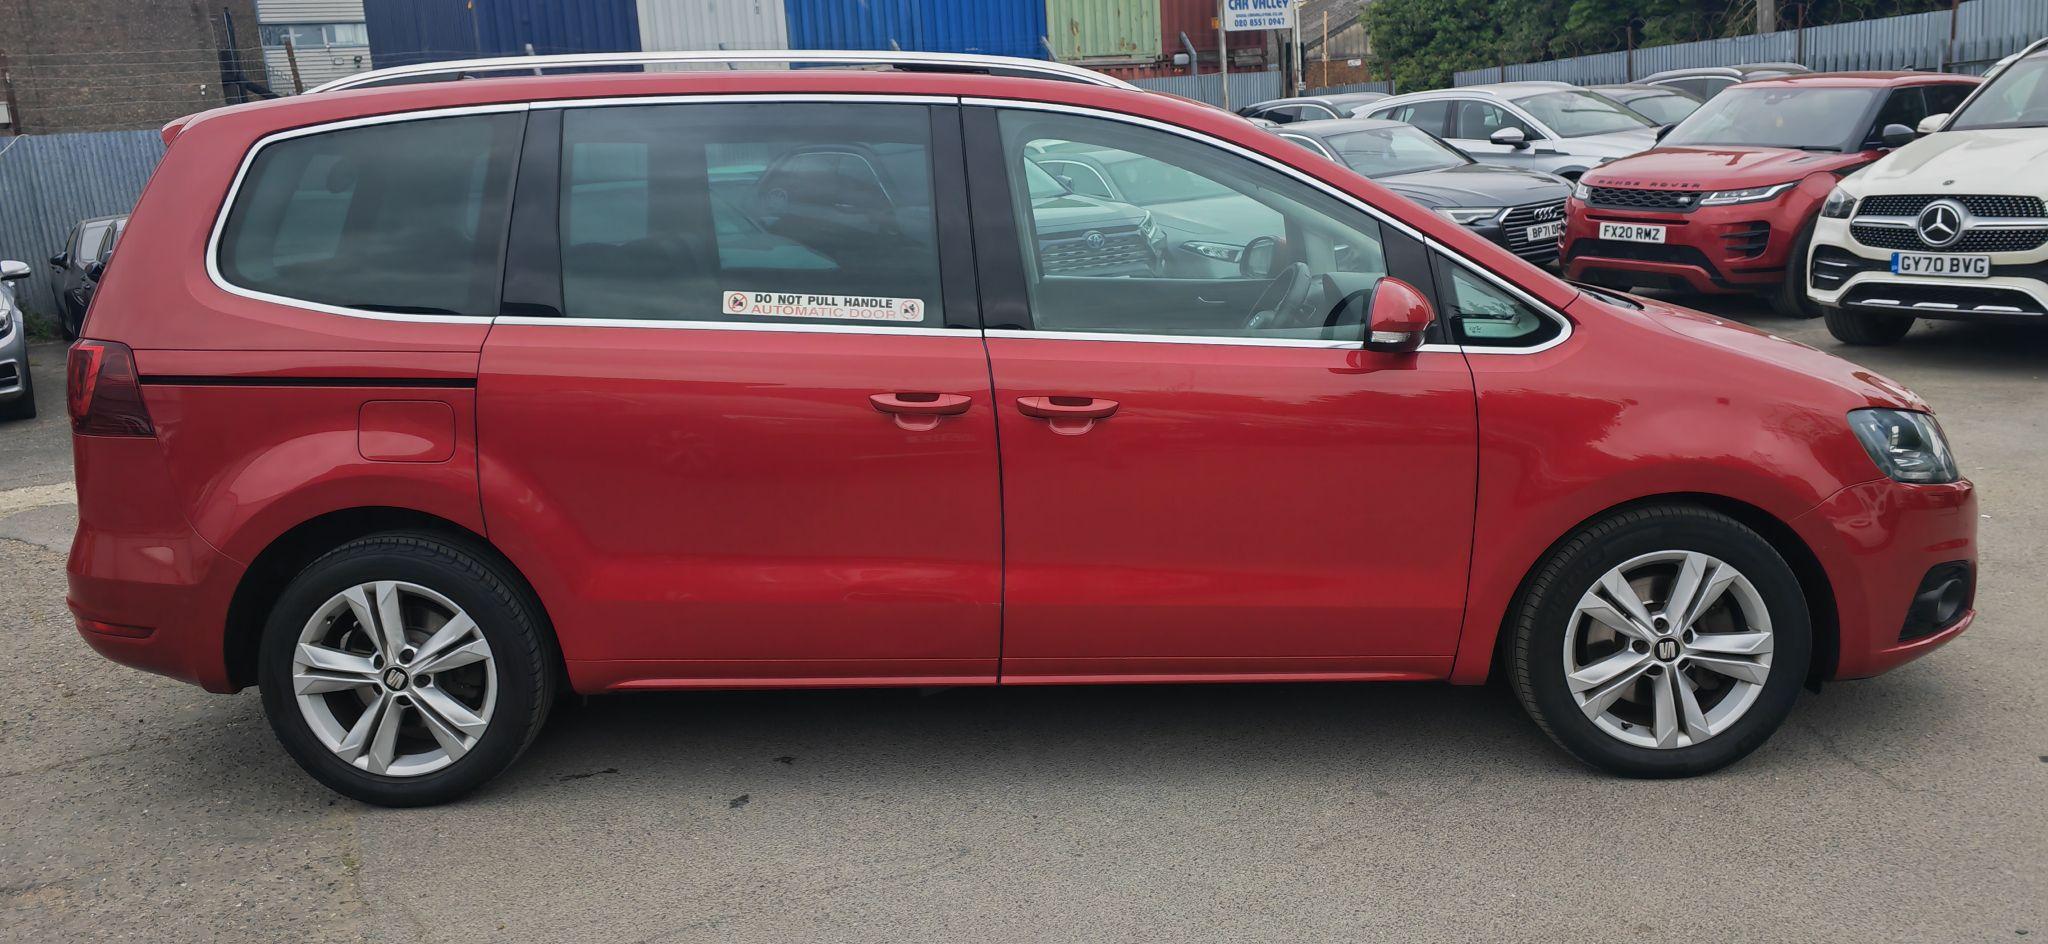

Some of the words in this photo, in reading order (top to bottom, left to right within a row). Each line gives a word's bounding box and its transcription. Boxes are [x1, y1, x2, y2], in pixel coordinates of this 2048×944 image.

[1229, 0, 1249, 10] CAR
[1252, 0, 1289, 9] VALLEY
[1235, 19, 1247, 27] 020
[1250, 18, 1266, 26] 8551
[1268, 18, 1285, 26] 0947
[1532, 226, 1550, 238] BP71
[1603, 225, 1633, 239] FX20
[1635, 227, 1660, 241] RMZ
[1901, 256, 1944, 272] GY70
[1949, 257, 1985, 273] BVG
[755, 294, 772, 304] DO
[778, 295, 802, 305] NOT
[808, 296, 838, 306] PULL
[844, 298, 893, 308] HANDLE
[751, 305, 844, 317] AUTOMATIC
[849, 308, 896, 319] DOOR
